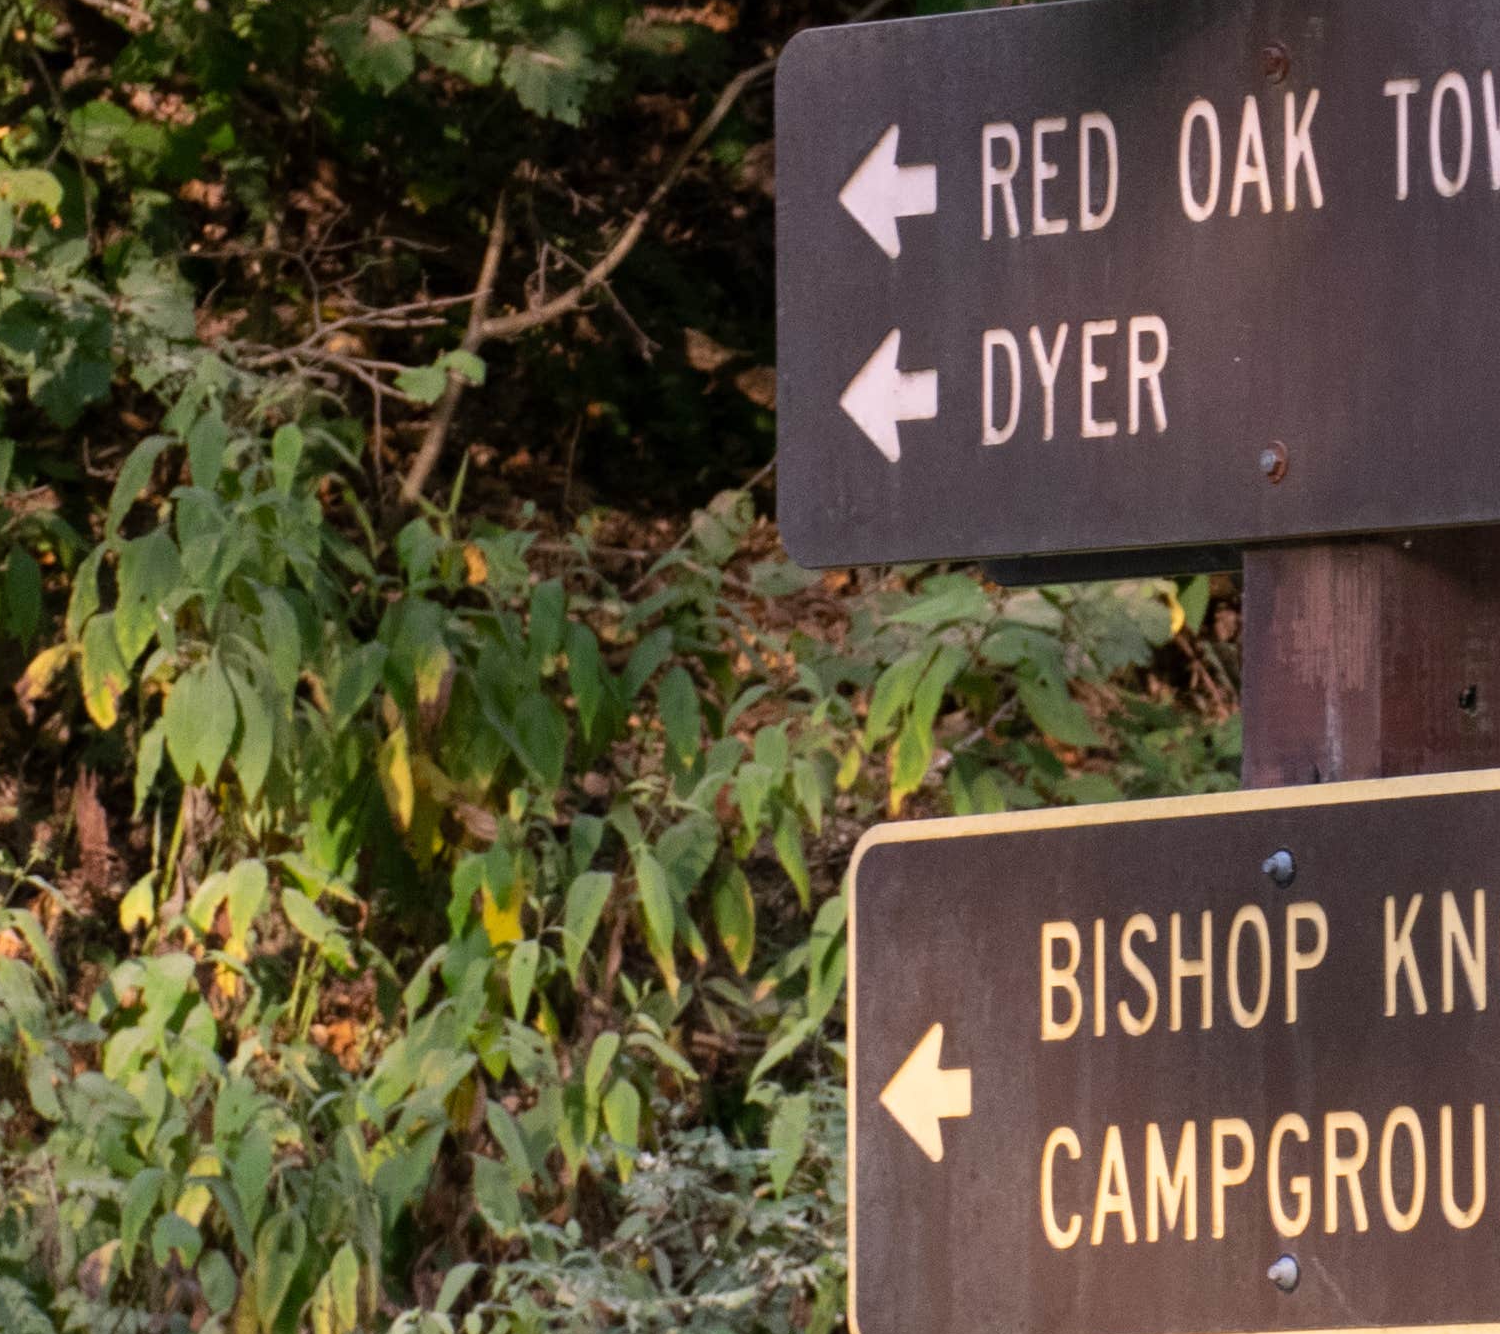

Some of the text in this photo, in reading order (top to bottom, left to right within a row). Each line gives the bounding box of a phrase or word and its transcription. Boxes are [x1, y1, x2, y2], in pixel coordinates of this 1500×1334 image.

[979, 111, 1119, 242] RED
[1178, 88, 1324, 224] OAK
[979, 314, 1170, 446] DYER
[1040, 900, 1328, 1043] BISHOP
